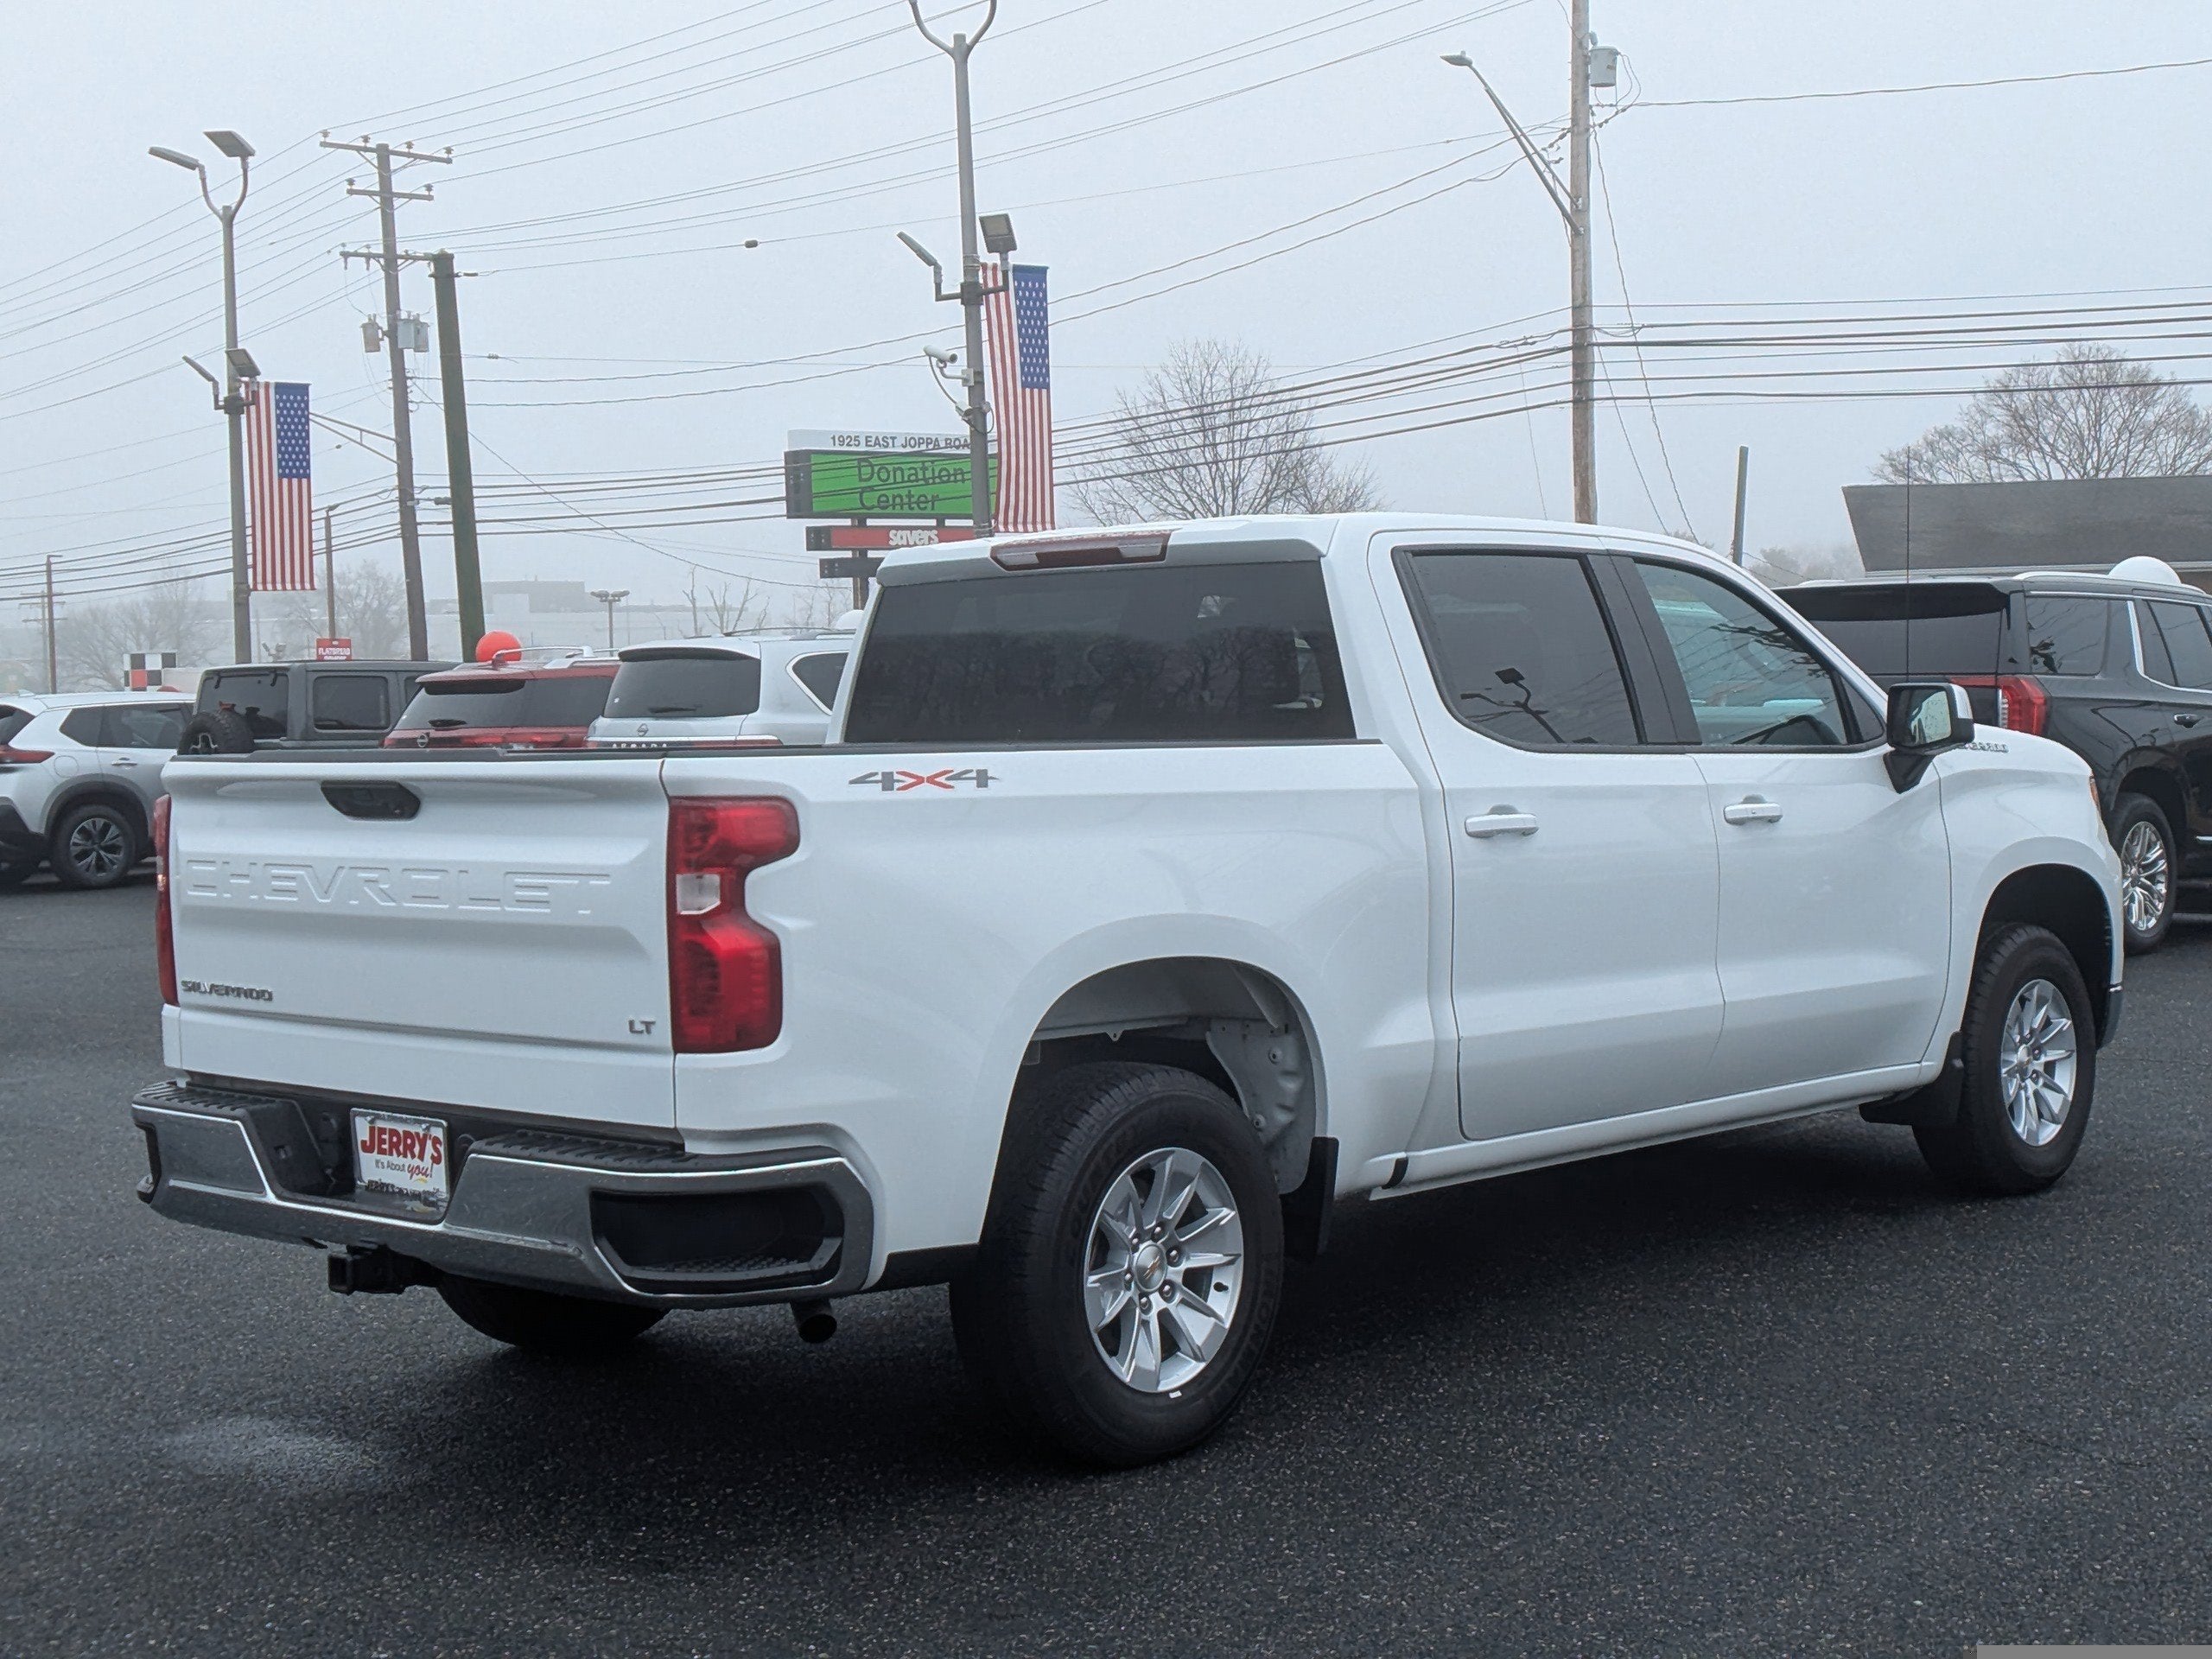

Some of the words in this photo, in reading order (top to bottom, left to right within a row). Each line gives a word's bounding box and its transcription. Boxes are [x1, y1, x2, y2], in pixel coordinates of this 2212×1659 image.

[830, 435, 861, 448] 1925
[865, 435, 898, 448] EAST
[901, 436, 941, 449] JOPPA
[944, 437, 971, 450] ROA
[857, 458, 967, 485] Donation
[858, 486, 940, 512] Center
[889, 530, 939, 546] savers
[186, 859, 612, 915] CHEVROLET
[181, 980, 274, 1001] SILVERADO
[628, 1019, 657, 1035] LT
[360, 1125, 442, 1166] JERRY'S
